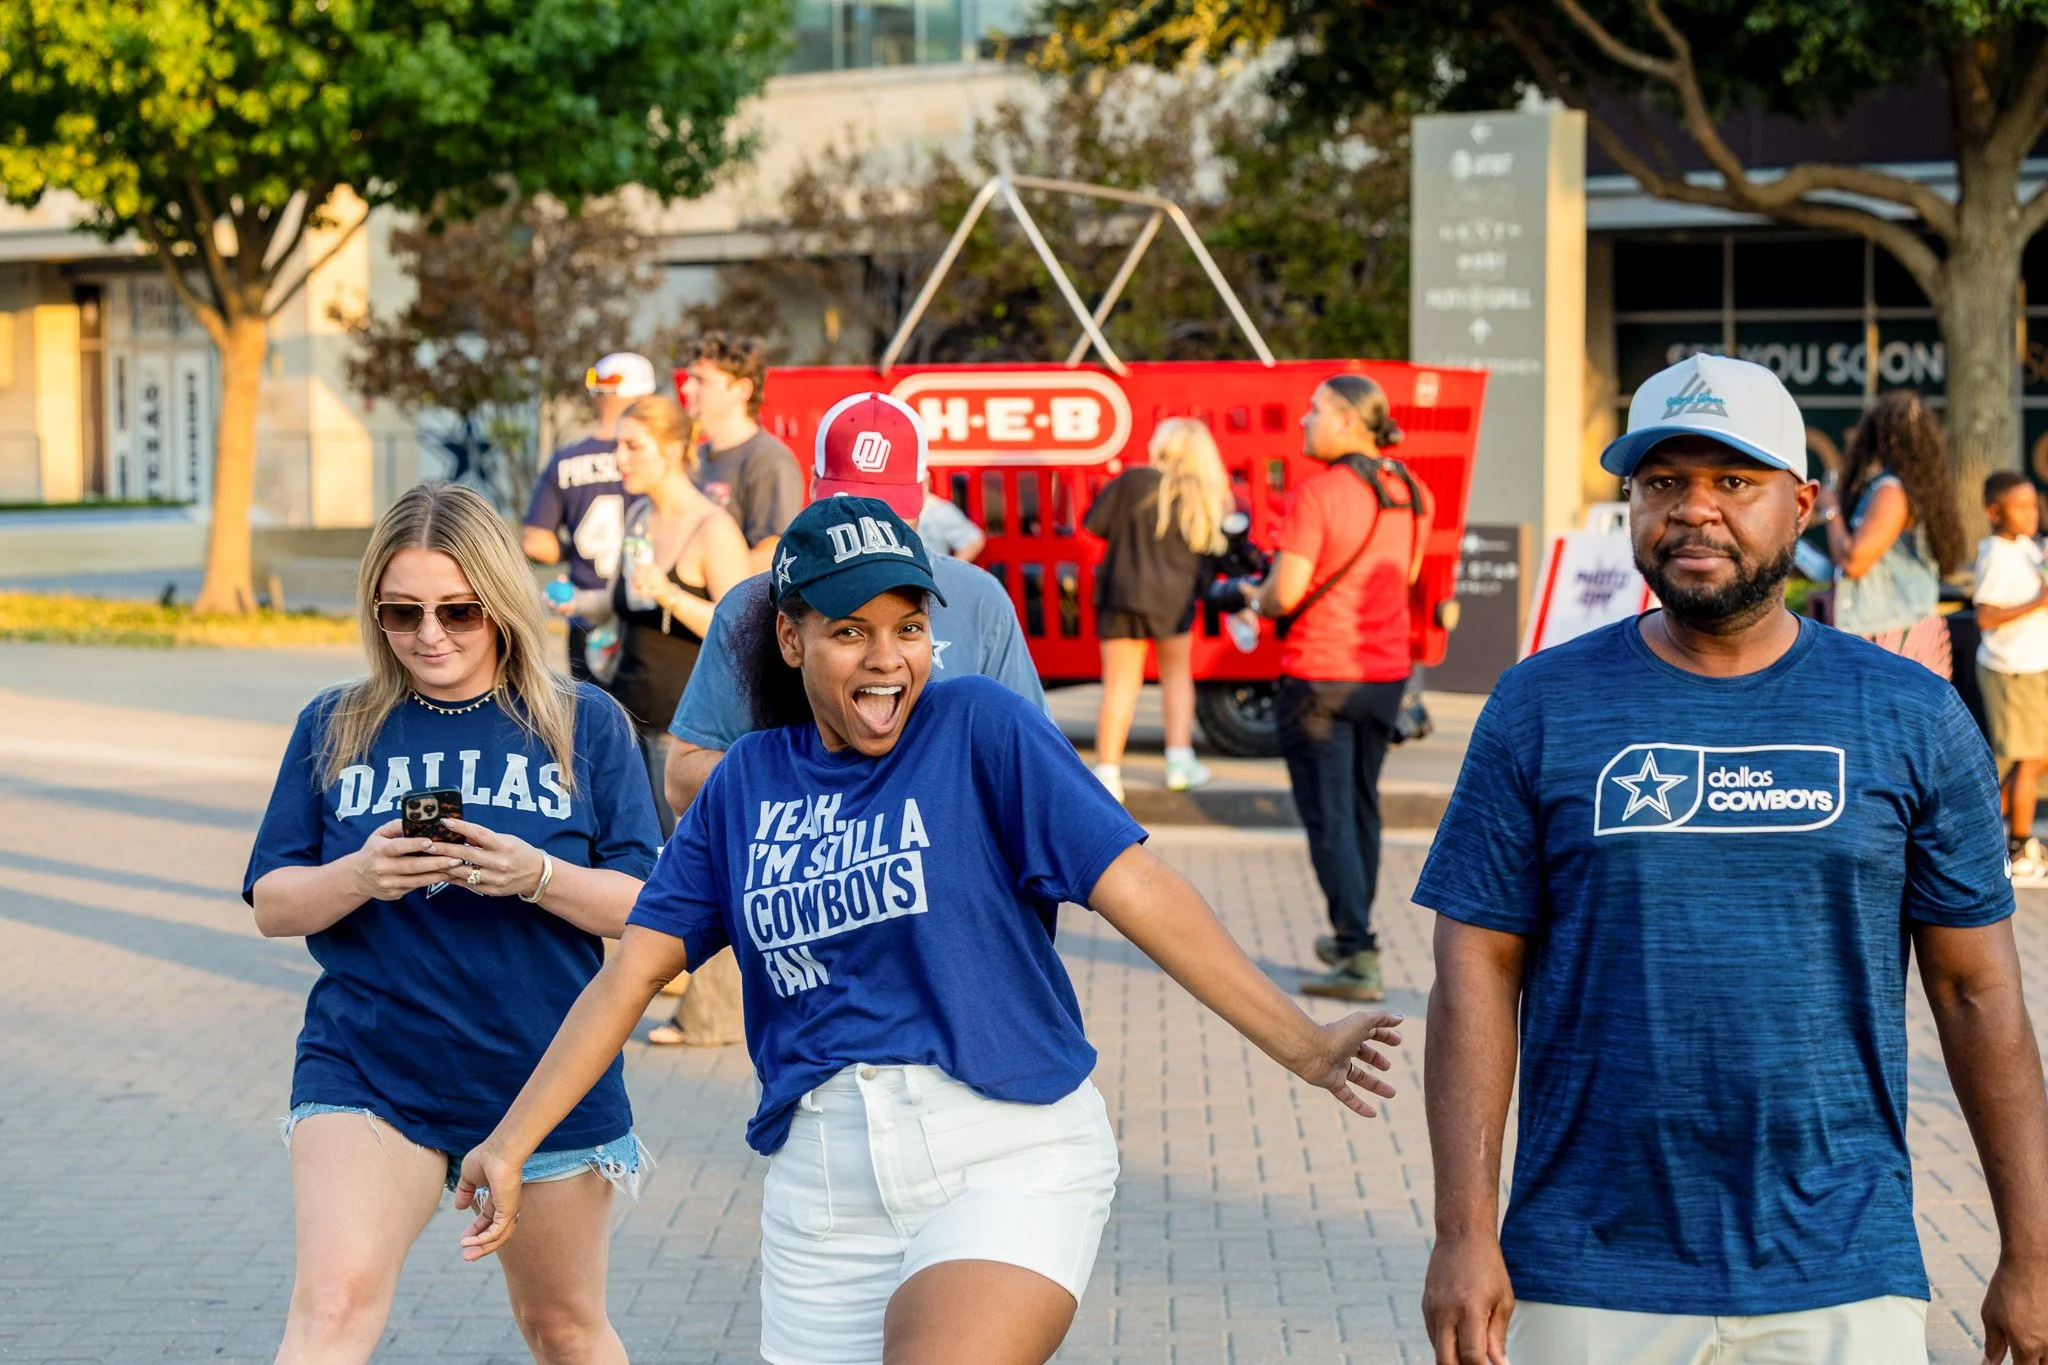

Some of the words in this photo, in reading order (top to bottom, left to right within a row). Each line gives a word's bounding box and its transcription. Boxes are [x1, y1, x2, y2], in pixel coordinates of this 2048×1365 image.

[1826, 341, 1945, 385] SOON
[573, 494, 624, 579] 4
[826, 515, 914, 563] DAL
[335, 750, 572, 822] DALLAS
[1707, 766, 1773, 788] dallas
[1707, 788, 1834, 812] COWBOYS
[744, 842, 801, 891] I'M
[803, 812, 889, 879] STILL
[899, 798, 931, 850] A
[750, 857, 917, 945] COWBOYS
